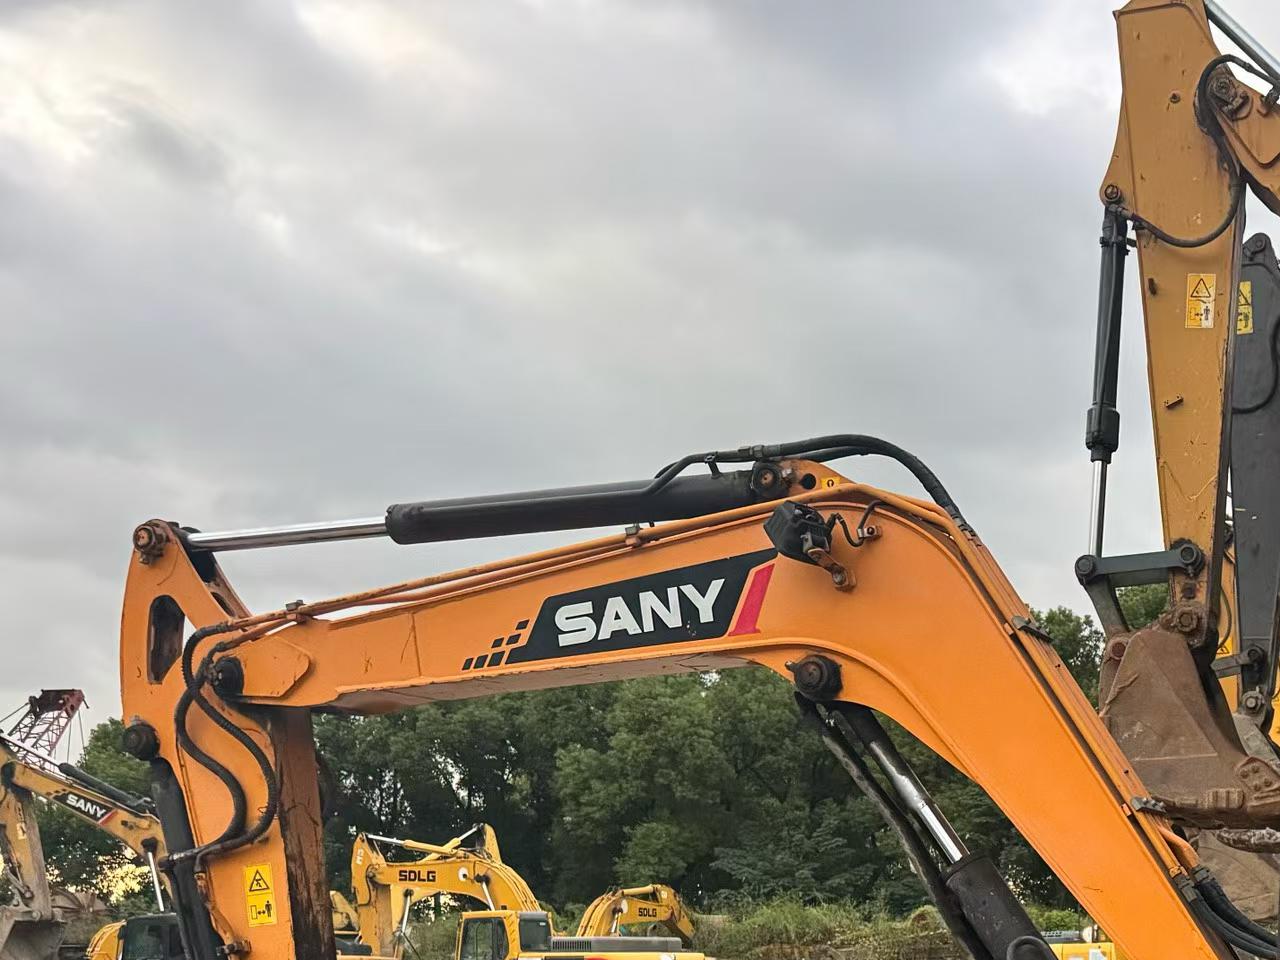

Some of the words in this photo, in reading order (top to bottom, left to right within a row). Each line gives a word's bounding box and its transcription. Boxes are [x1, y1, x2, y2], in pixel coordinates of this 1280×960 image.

[554, 577, 726, 647] SANY
[66, 794, 106, 818] SANY
[398, 870, 436, 882] SDLG
